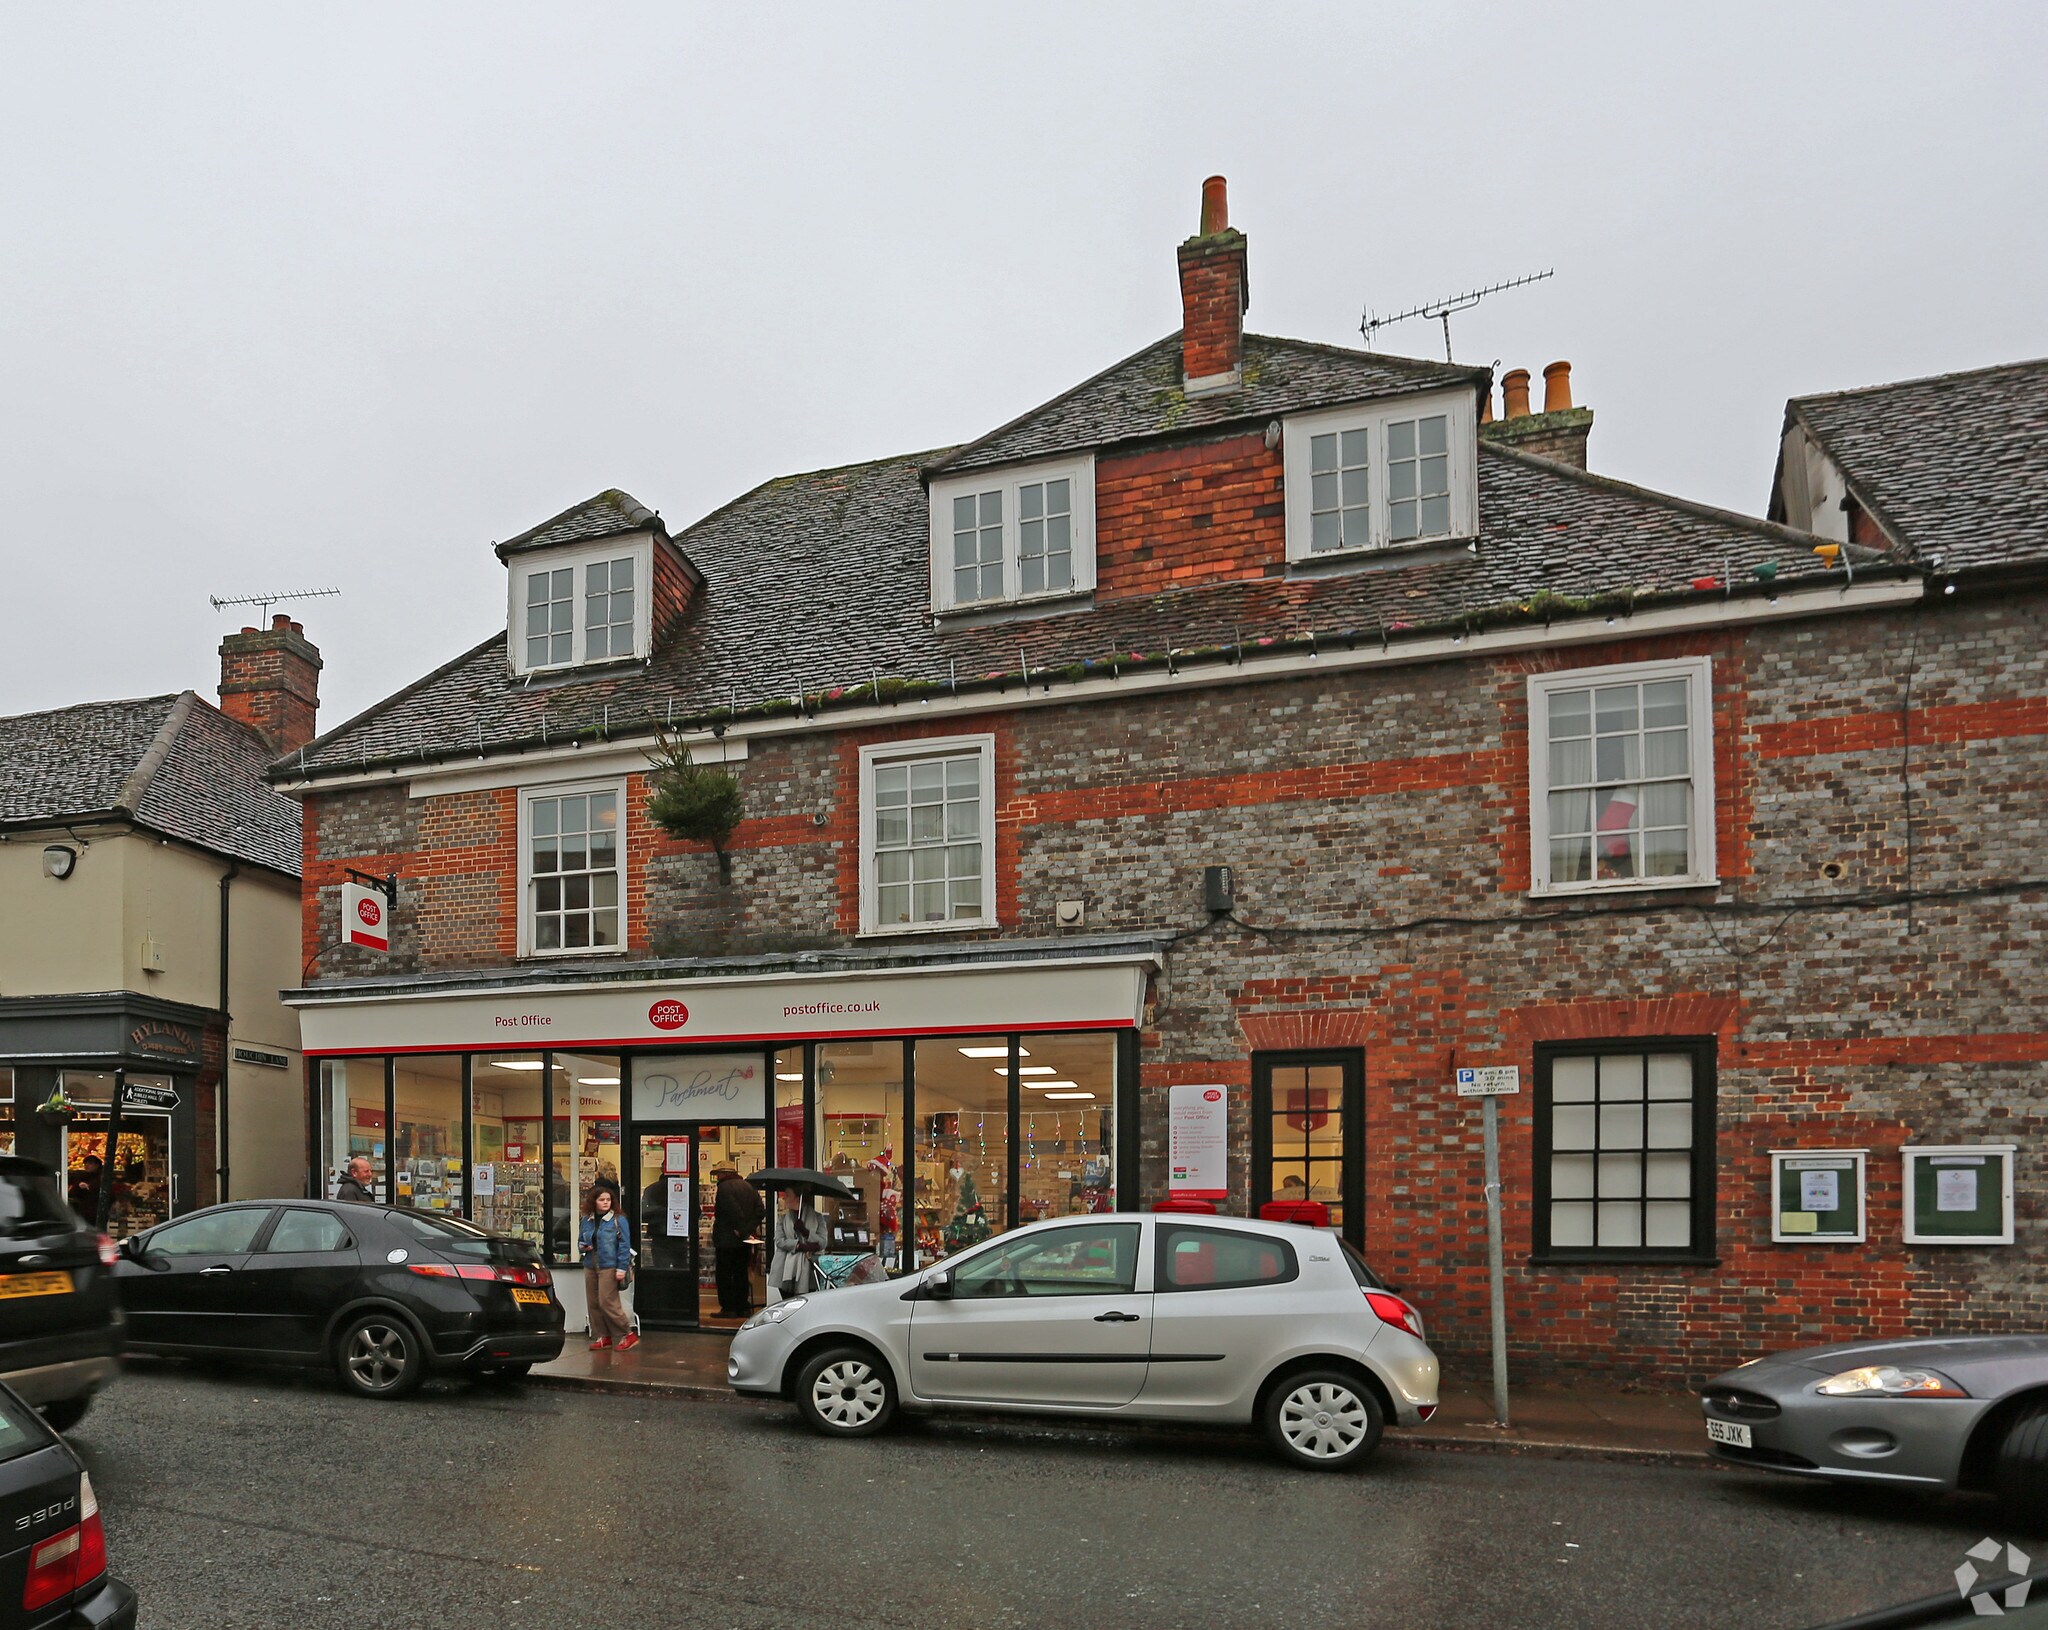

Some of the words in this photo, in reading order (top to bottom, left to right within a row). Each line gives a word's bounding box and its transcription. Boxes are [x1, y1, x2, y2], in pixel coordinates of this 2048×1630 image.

[363, 902, 377, 913] POST
[360, 909, 379, 922] OFFICE
[657, 1005, 680, 1014] POST
[783, 1000, 880, 1018] postoffice.co.uk
[495, 1016, 518, 1027] Post
[521, 1014, 552, 1026] Office
[652, 1014, 684, 1023] OFFICE
[131, 1021, 196, 1053] HYLANDS
[270, 1055, 287, 1066] LANE
[644, 1068, 744, 1108] Parchment
[579, 1096, 603, 1106] Office
[1726, 1425, 1743, 1444] JXK
[15, 1496, 75, 1531] 330d
